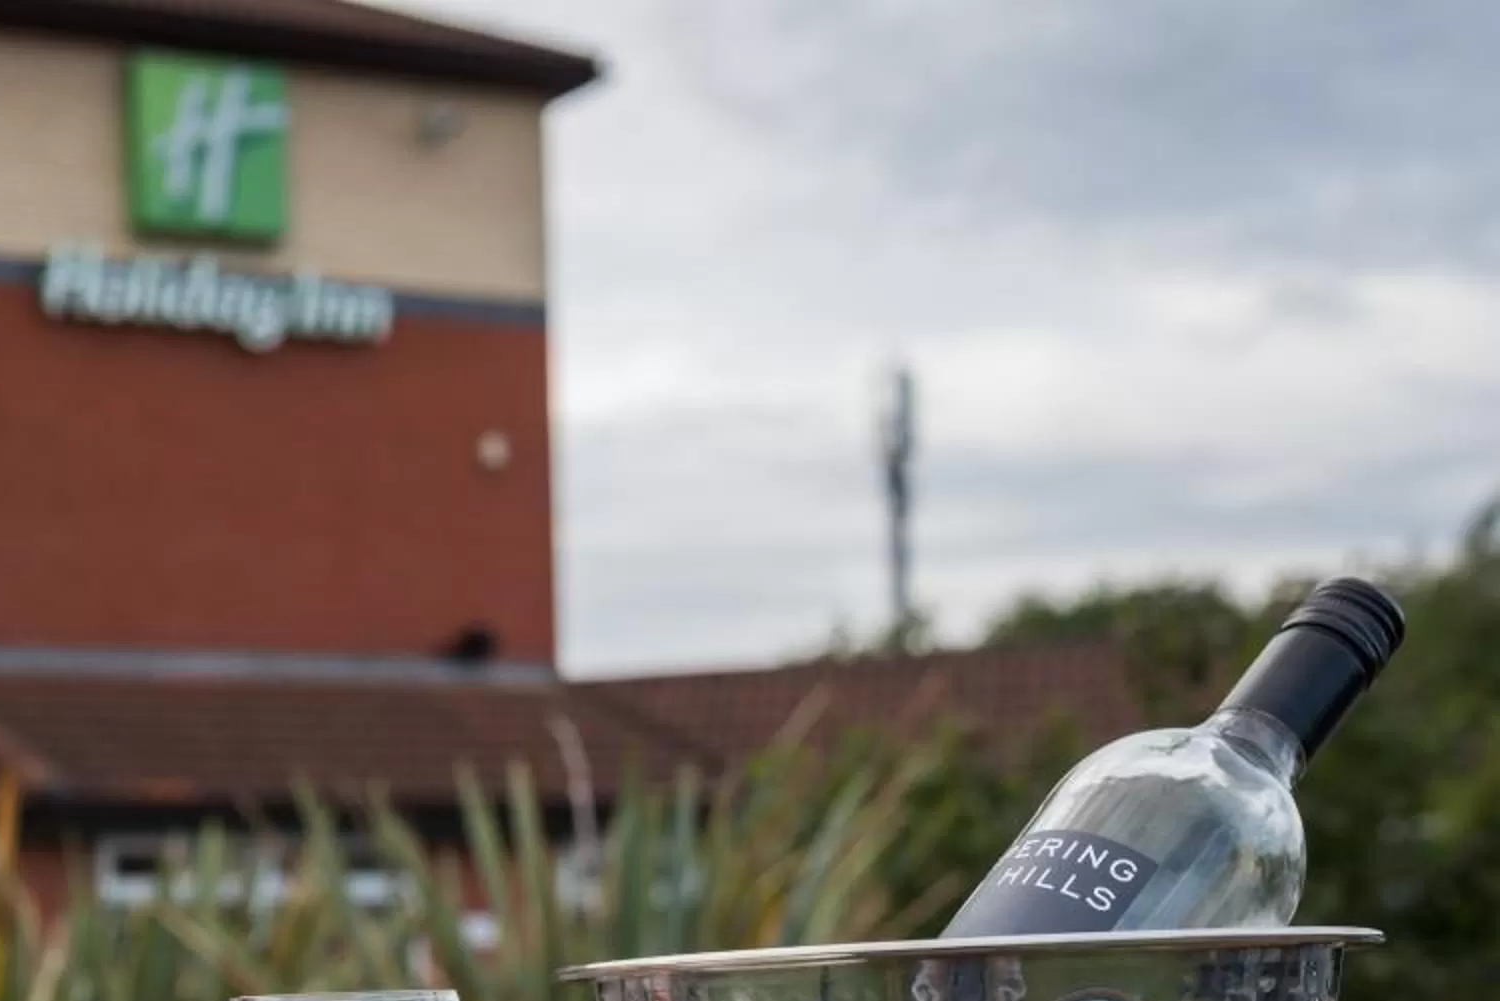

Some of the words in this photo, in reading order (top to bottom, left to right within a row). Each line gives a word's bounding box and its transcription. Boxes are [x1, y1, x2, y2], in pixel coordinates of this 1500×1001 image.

[42, 238, 286, 352] Holiday
[294, 268, 393, 341] Inn
[1009, 838, 1137, 882] ERING
[997, 866, 1116, 911] HILLS
